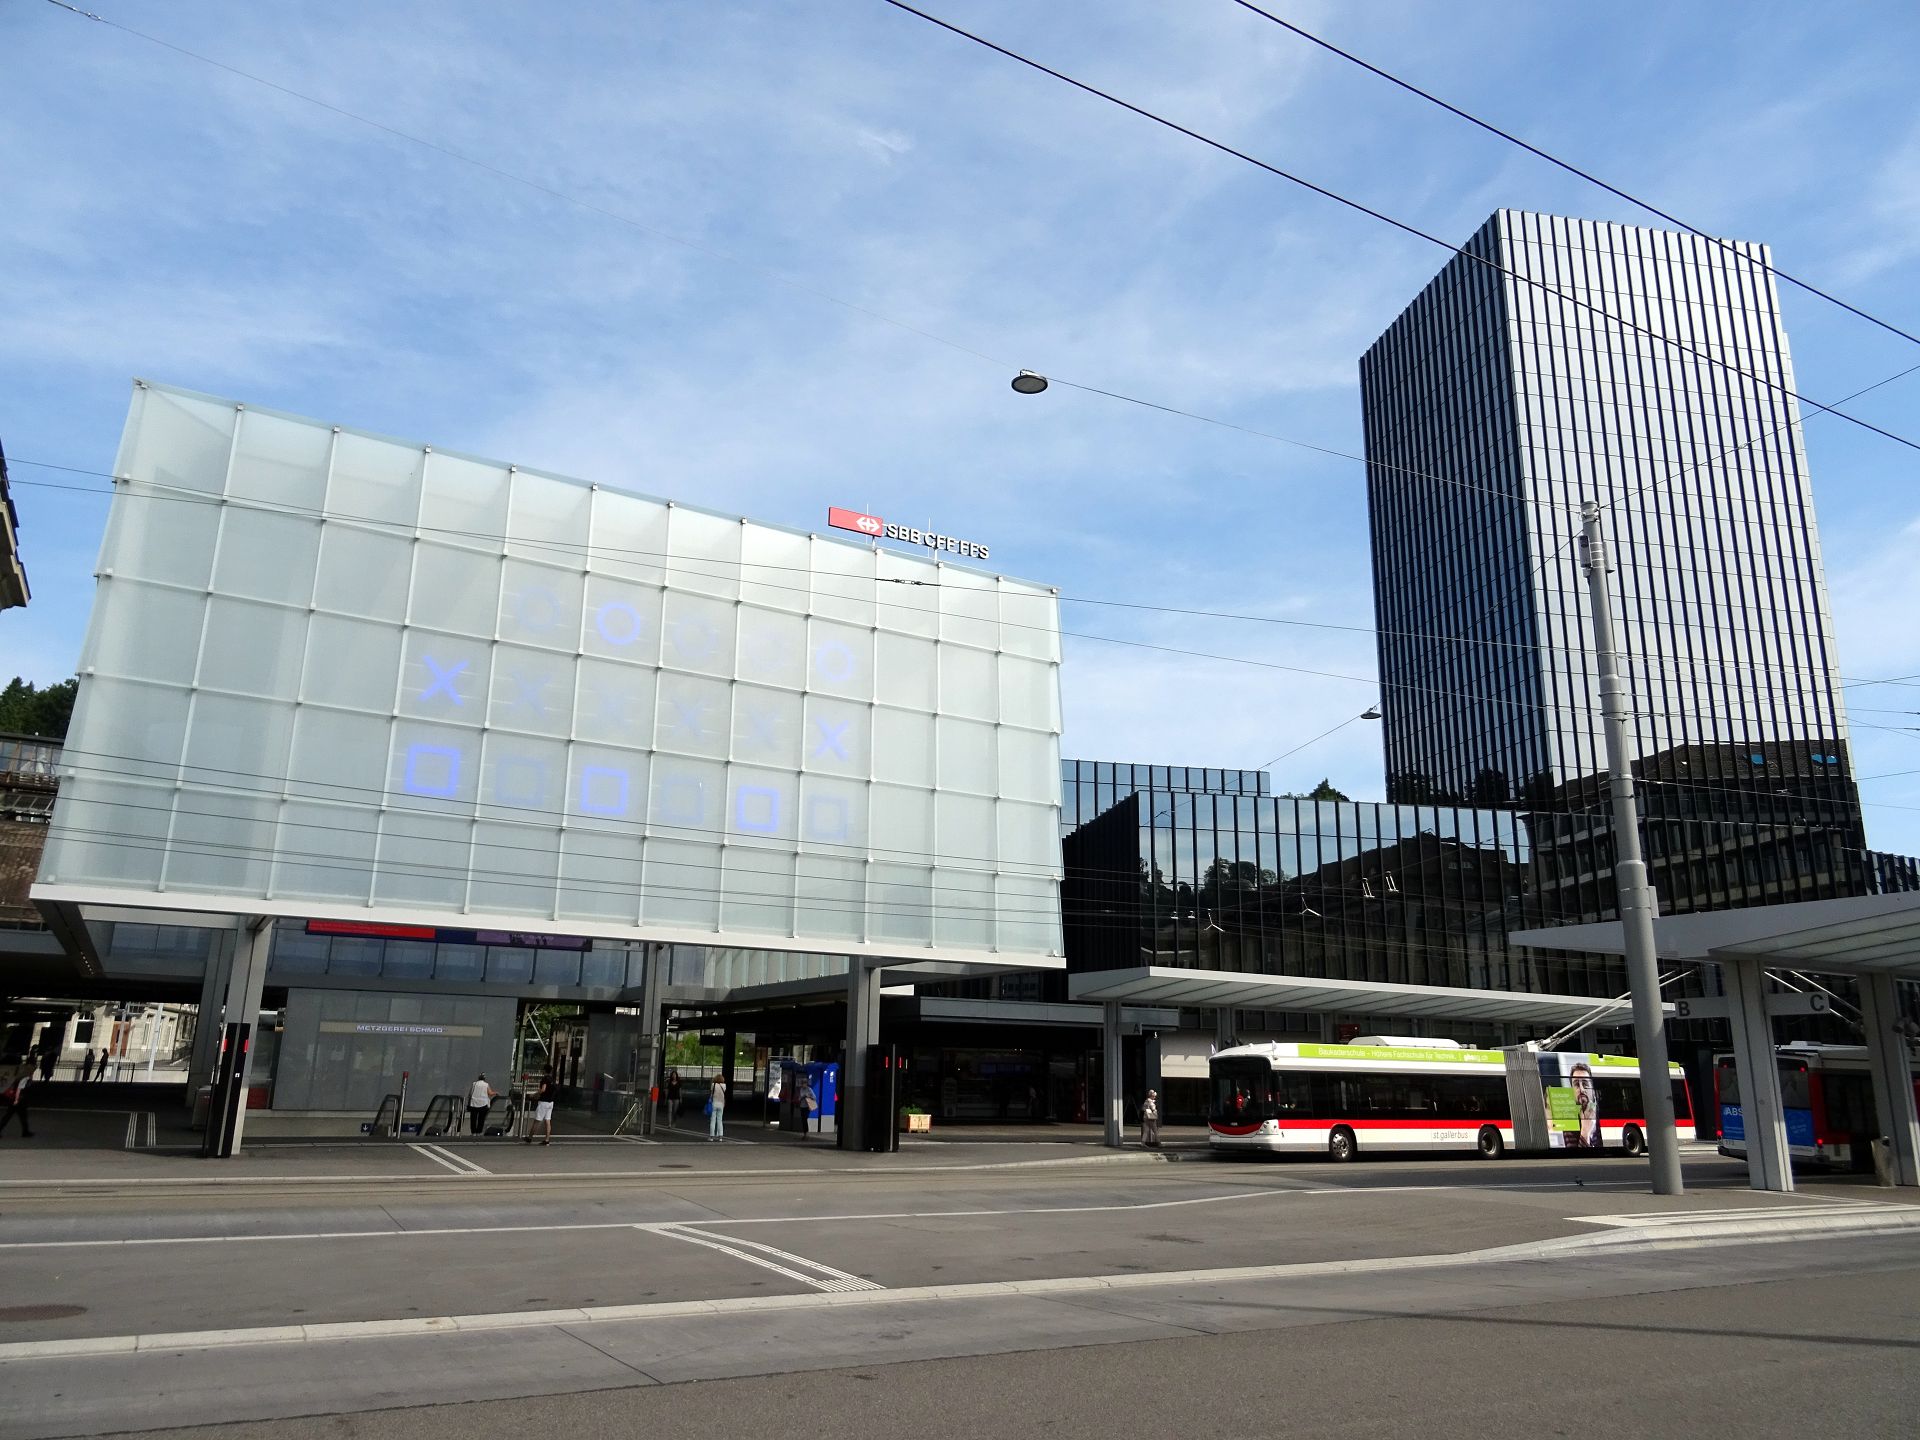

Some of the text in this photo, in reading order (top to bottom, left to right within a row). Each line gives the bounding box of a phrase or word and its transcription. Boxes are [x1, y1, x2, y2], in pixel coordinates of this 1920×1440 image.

[886, 523, 921, 545] SBB
[1678, 1001, 1691, 1017] B
[1809, 994, 1825, 1012] C
[1133, 1024, 1140, 1034] A
